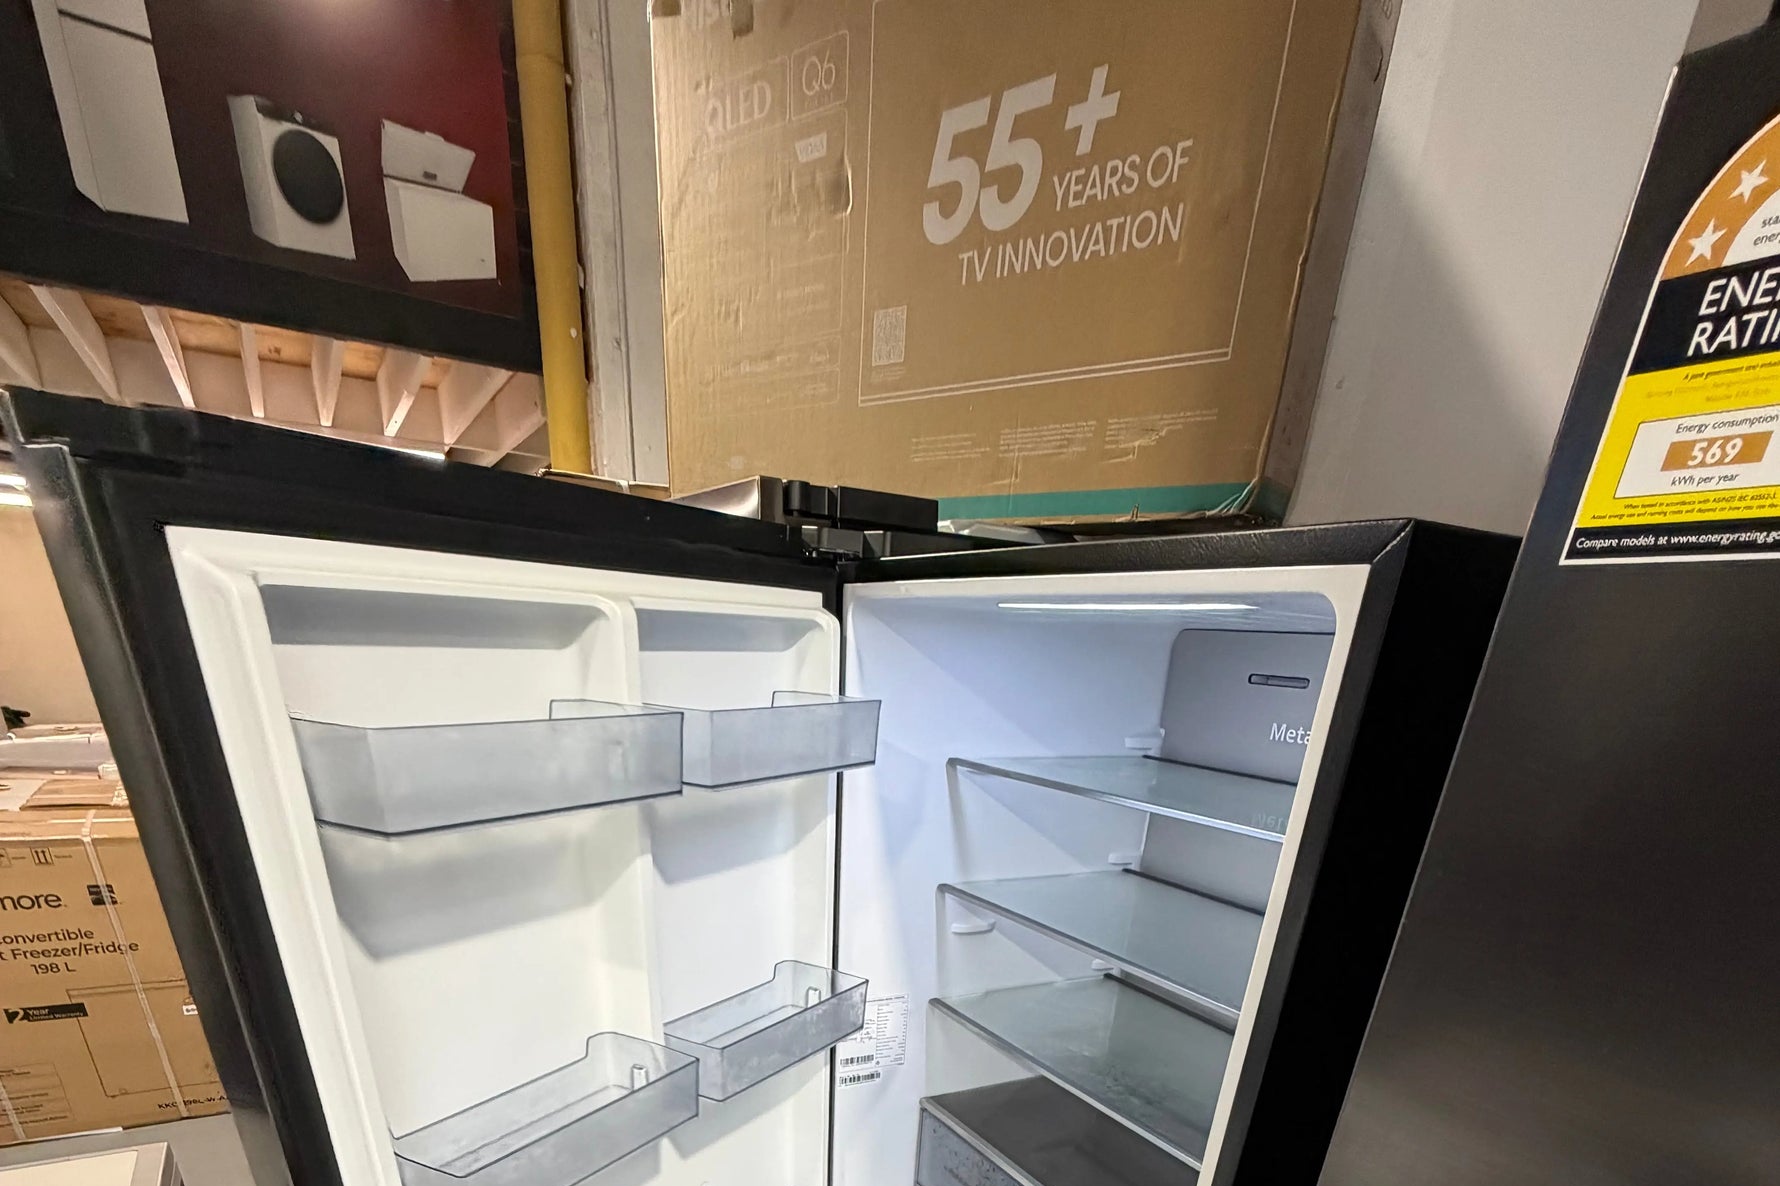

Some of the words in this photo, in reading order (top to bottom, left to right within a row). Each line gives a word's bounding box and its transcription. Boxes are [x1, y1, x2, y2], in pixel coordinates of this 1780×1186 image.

[801, 50, 837, 96] Q6
[922, 63, 1122, 246] 55+
[1052, 153, 1141, 213] YEARS
[1146, 138, 1194, 188] OF
[1760, 214, 1780, 230] sta
[958, 247, 992, 286] TV
[996, 202, 1185, 279] INNOVATION
[1752, 231, 1780, 247] ener
[1698, 266, 1780, 317] ENE
[1675, 423, 1710, 435] Energy
[1712, 413, 1779, 430] consumption
[1687, 437, 1743, 466] 569
[1670, 475, 1695, 487] kWh
[1696, 476, 1714, 487] per
[1717, 473, 1740, 484] year
[1576, 537, 1618, 550] Compare
[1620, 534, 1656, 546] models
[1657, 536, 1667, 545] at
[0, 928, 94, 946] onvertible
[12, 941, 140, 961] Freezer/Fridge
[31, 962, 61, 975] 198
[64, 962, 77, 973] L
[27, 1008, 50, 1016] Year
